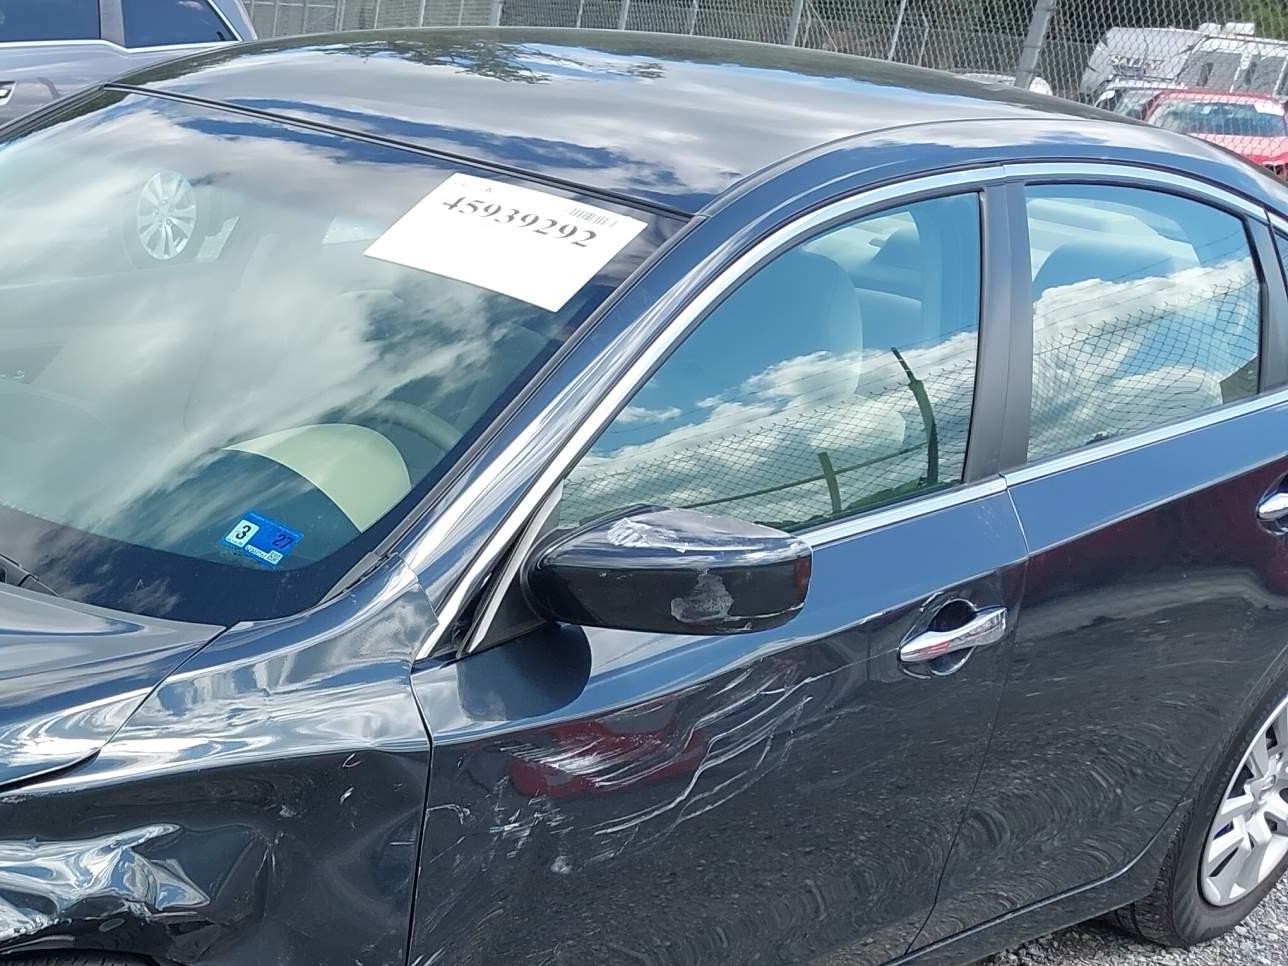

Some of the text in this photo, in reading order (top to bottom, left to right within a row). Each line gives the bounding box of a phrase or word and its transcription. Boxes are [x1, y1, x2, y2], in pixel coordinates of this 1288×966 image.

[442, 196, 597, 248] 45939292
[235, 524, 252, 540] 3
[272, 533, 294, 549] 27
